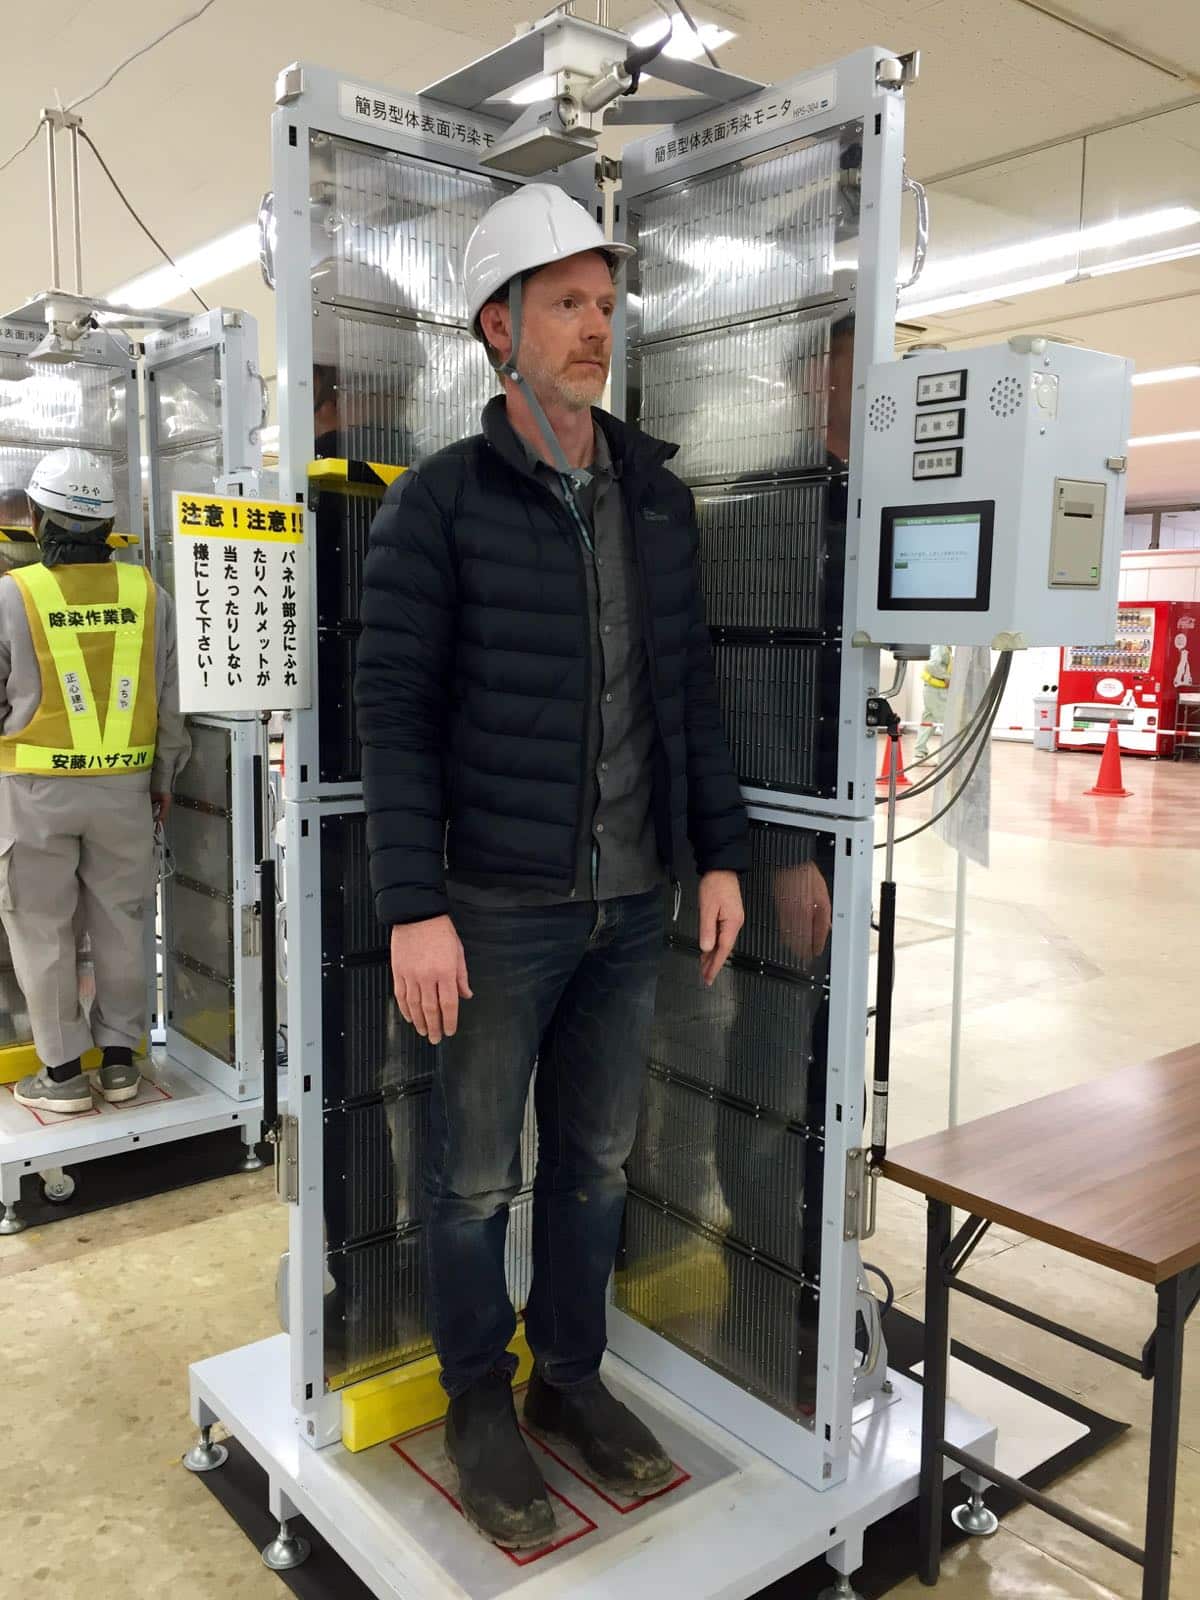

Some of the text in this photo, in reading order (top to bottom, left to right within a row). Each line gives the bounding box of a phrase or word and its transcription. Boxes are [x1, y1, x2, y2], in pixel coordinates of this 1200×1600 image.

[654, 98, 792, 164] 簡易型体表面汚染モニタ
[68, 484, 101, 497] つちや
[49, 607, 138, 628] 除染作業員
[192, 542, 213, 688] 様にして下さい！
[223, 545, 242, 687] 当たったりしない
[253, 547, 271, 687] たりヘルメットが
[281, 550, 298, 687] パネル部分にふれ
[52, 751, 148, 769] 安藤ハザマJV
